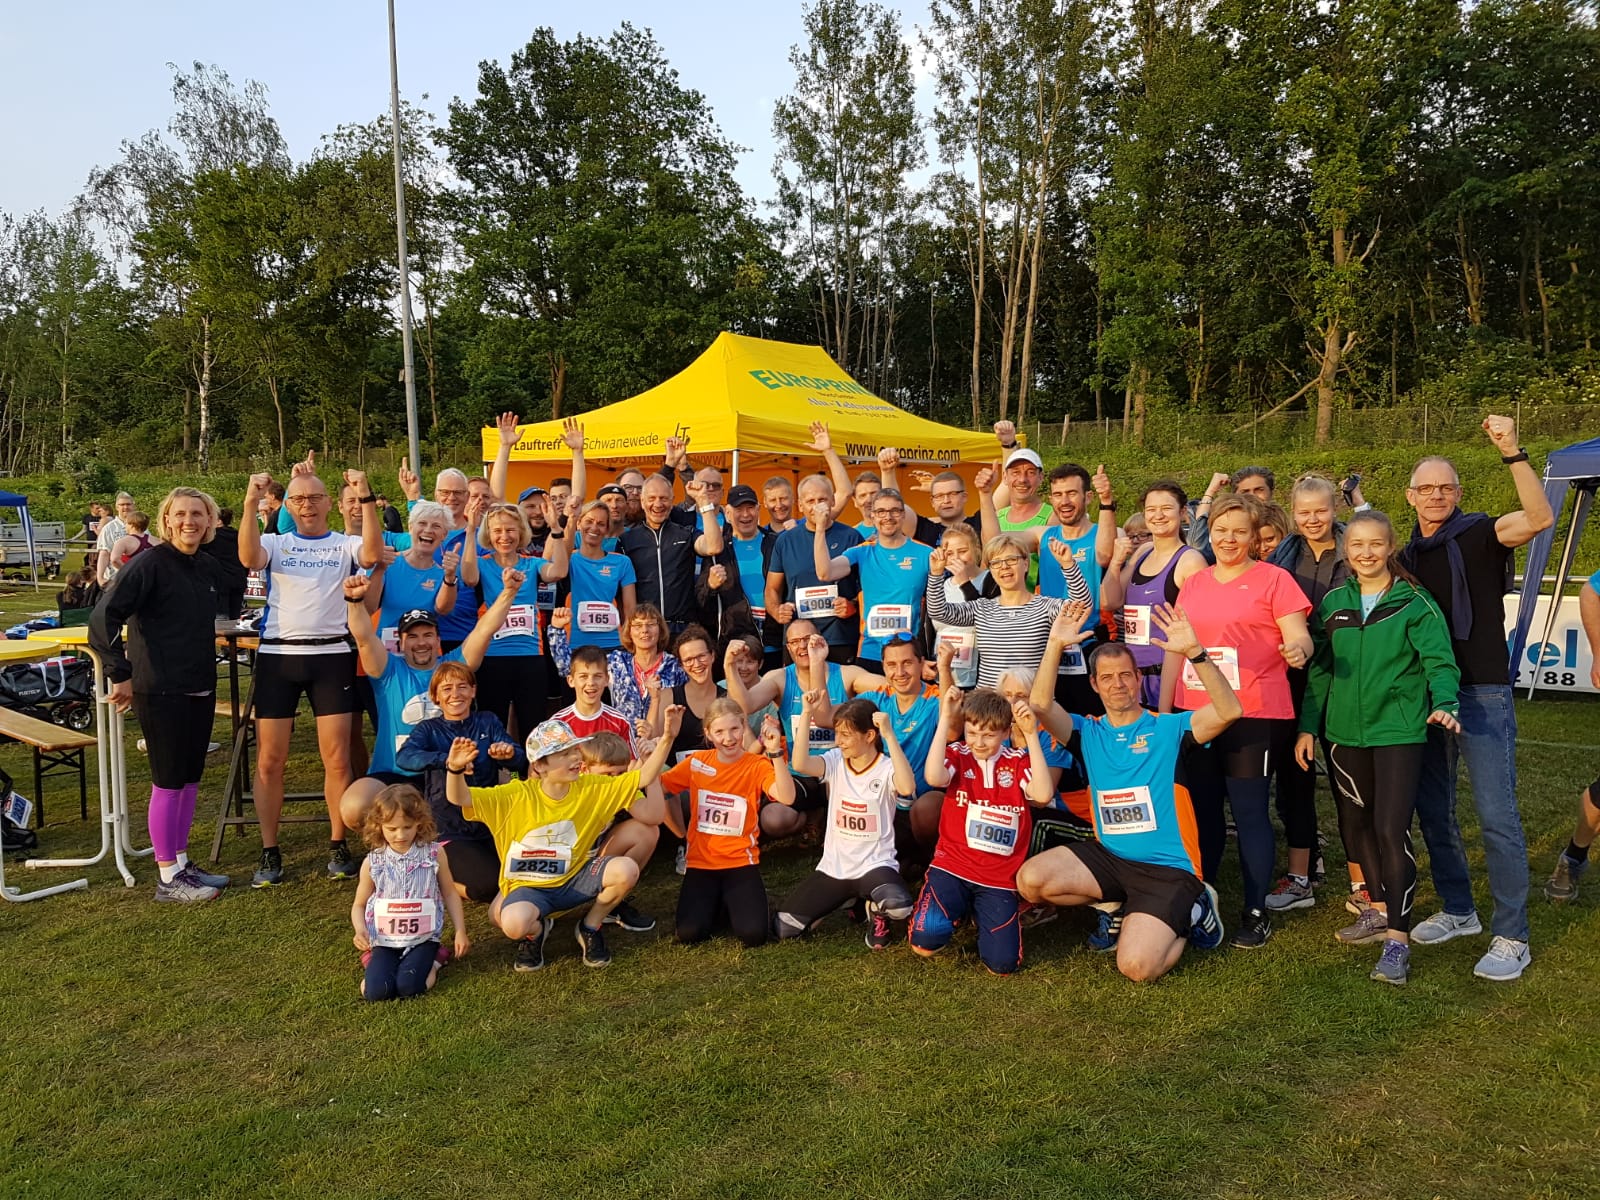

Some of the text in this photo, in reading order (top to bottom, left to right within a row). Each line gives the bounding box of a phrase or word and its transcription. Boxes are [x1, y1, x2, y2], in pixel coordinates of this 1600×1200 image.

[513, 432, 659, 451] Lauftreff Schwanewede
[281, 557, 340, 568] die nordsee
[804, 598, 833, 611] 1909
[589, 613, 609, 624] 165
[874, 617, 902, 629] 1901
[705, 808, 729, 825] 161
[1105, 806, 1144, 823] 1888
[842, 815, 866, 831] 160
[975, 823, 1011, 845] 1905
[516, 860, 558, 874] 2825
[388, 918, 419, 935] 155
